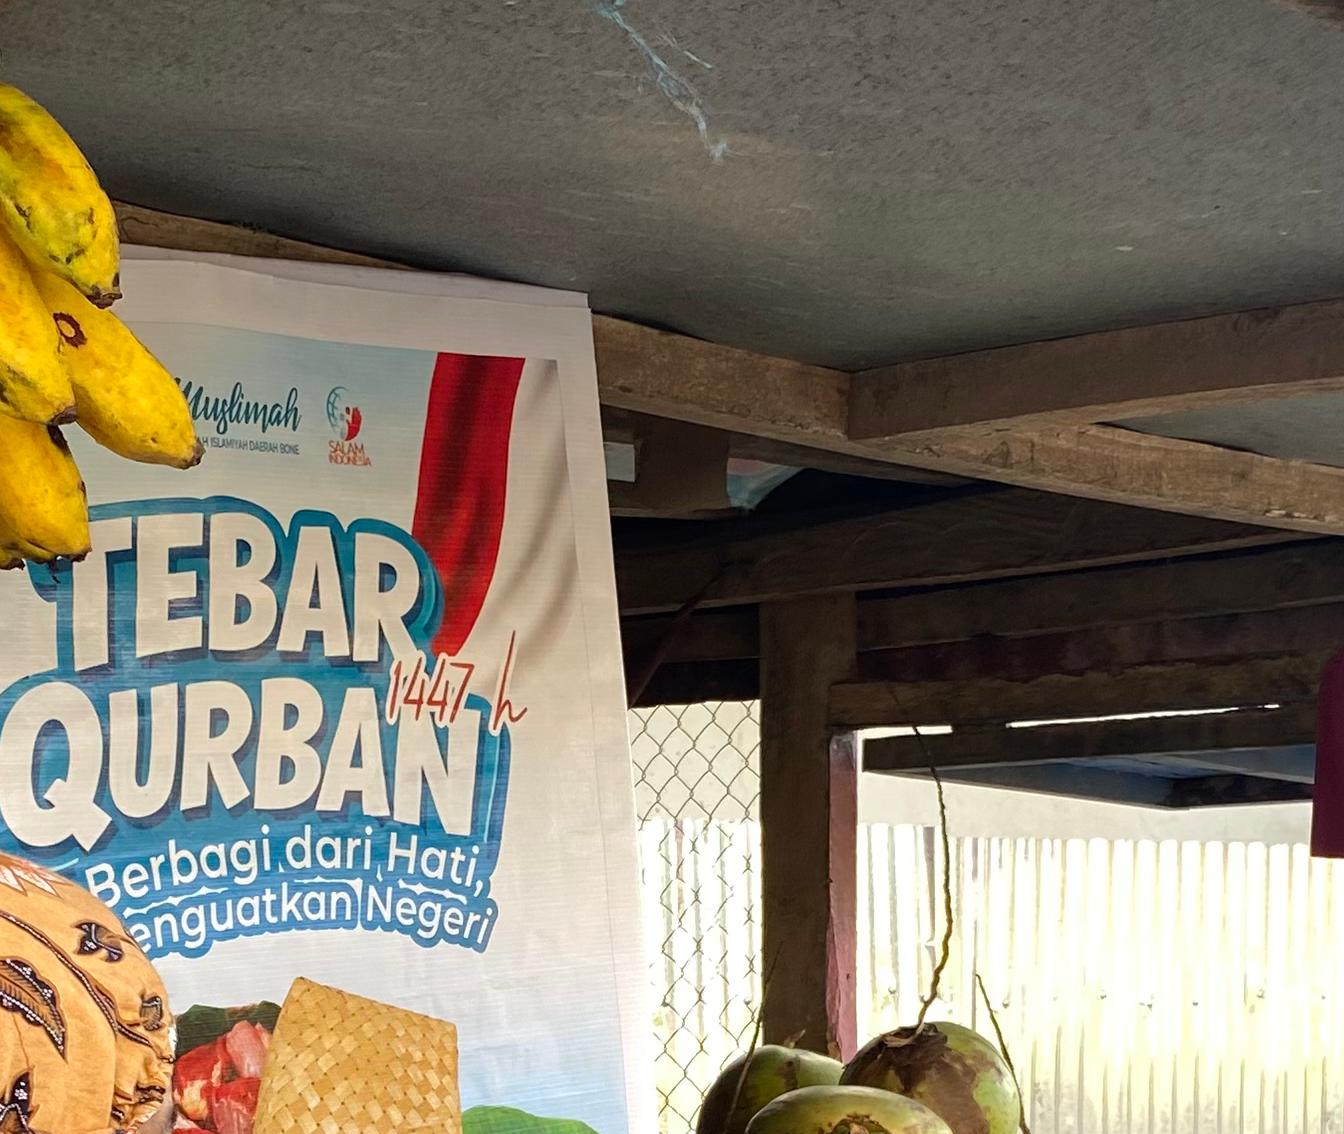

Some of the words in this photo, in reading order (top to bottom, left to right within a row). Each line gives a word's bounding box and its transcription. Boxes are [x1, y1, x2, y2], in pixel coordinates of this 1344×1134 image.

[328, 440, 364, 454] SALAM
[72, 511, 422, 672] TEBAR
[388, 658, 474, 724] 1447
[85, 824, 271, 906] Berbagi
[285, 824, 372, 871] dari
[388, 831, 484, 897] Hati,
[133, 882, 352, 954] enguatkan
[367, 885, 494, 944] Negeri
